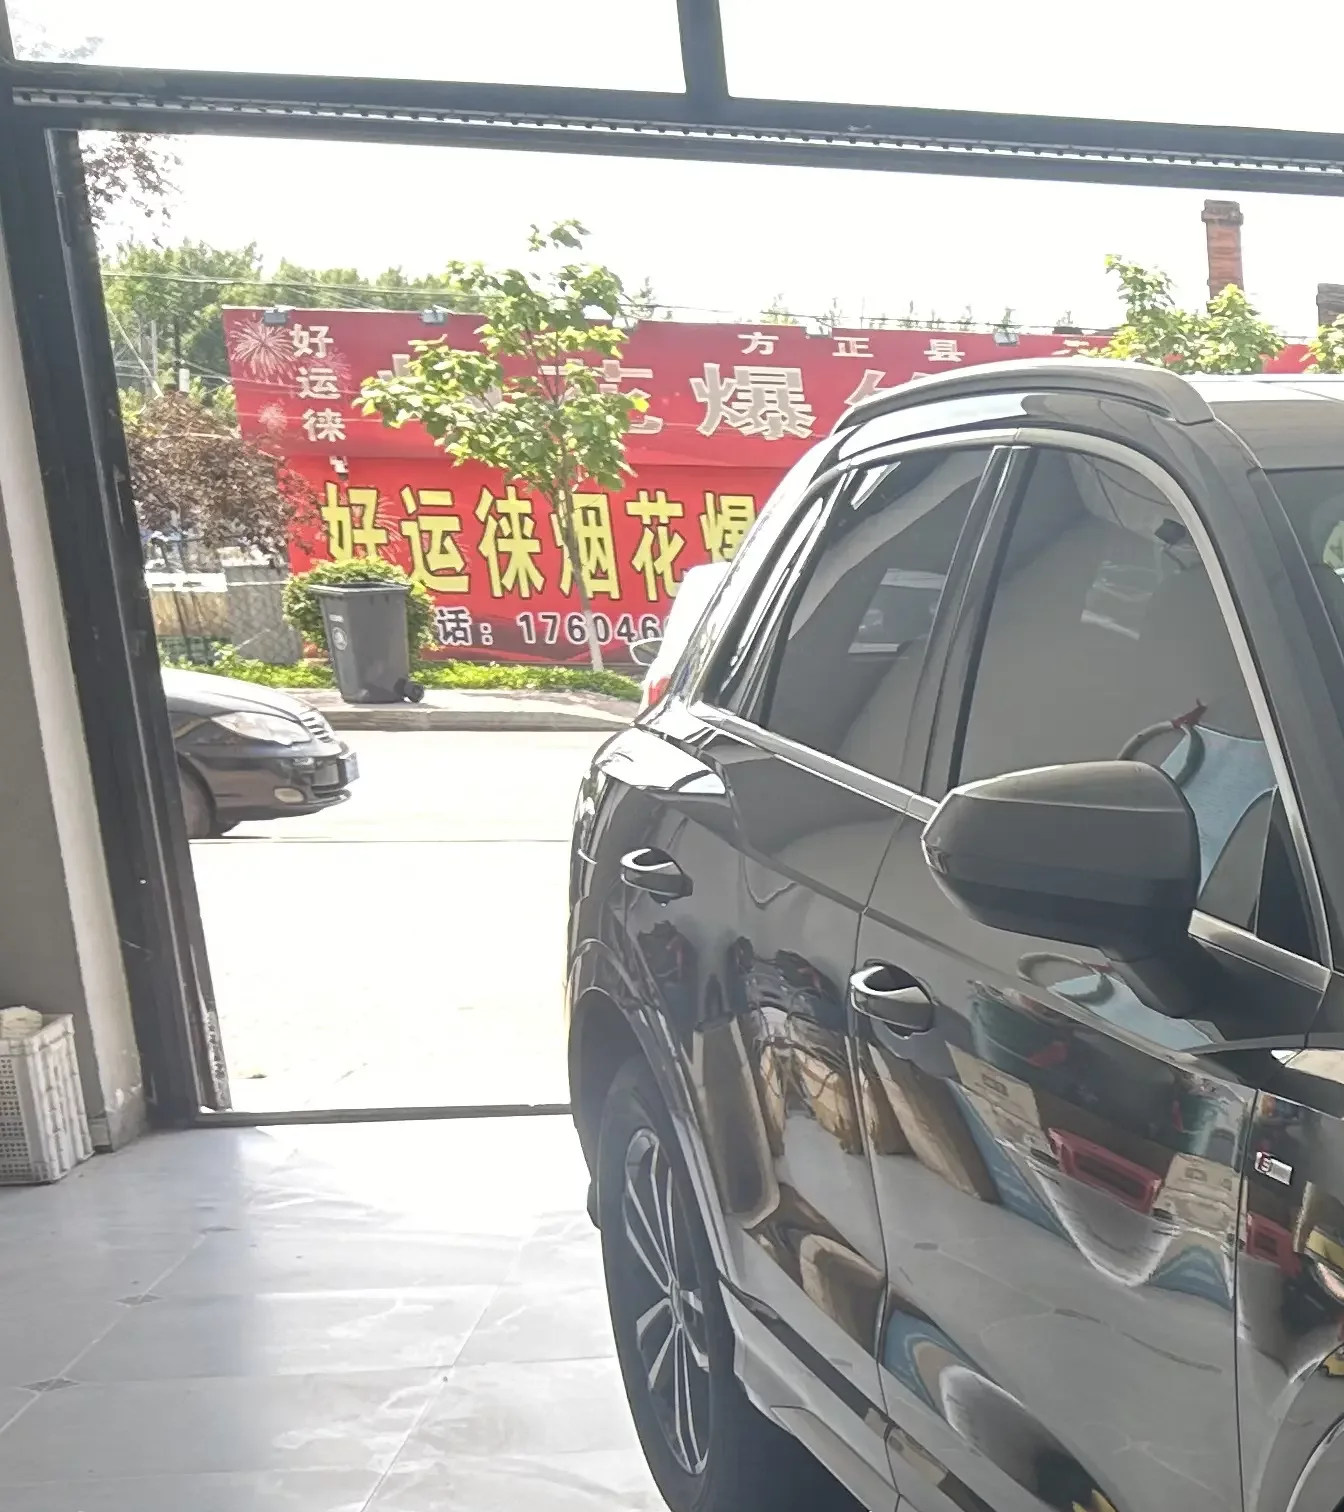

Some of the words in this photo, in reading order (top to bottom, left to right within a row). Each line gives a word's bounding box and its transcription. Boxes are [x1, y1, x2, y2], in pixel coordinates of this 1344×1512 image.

[738, 331, 966, 363] 方正县
[515, 611, 672, 645] 176046
